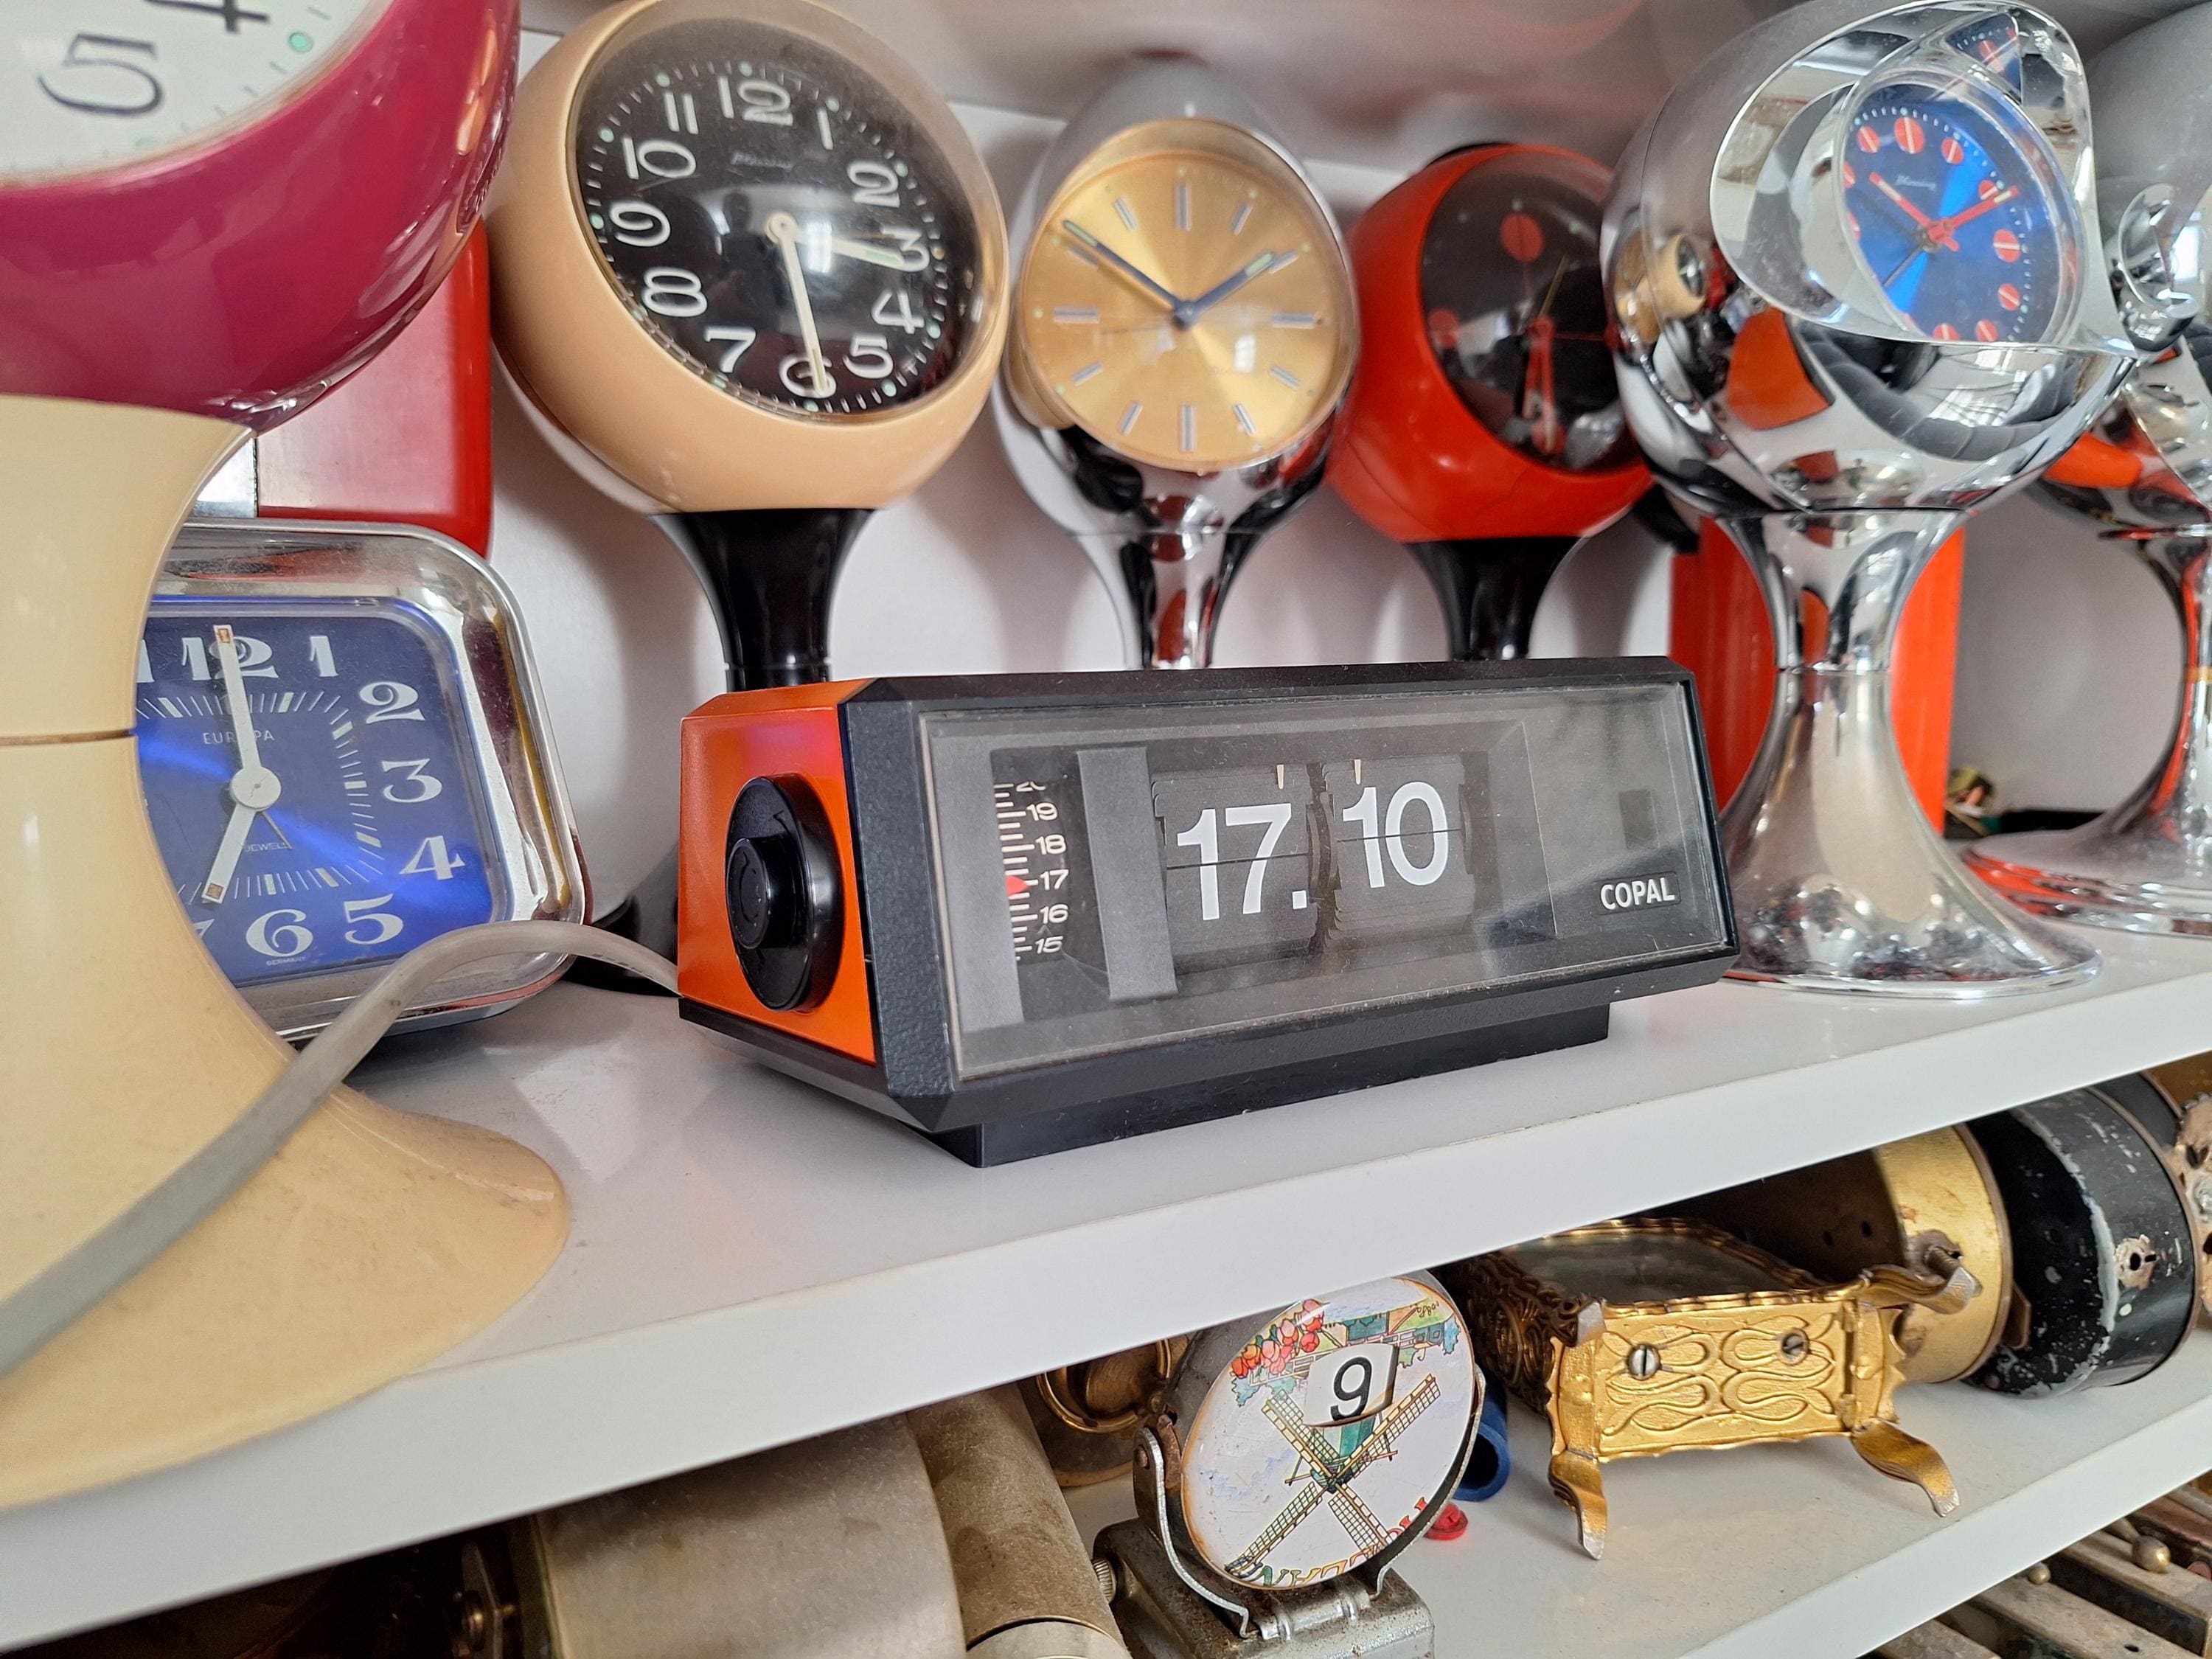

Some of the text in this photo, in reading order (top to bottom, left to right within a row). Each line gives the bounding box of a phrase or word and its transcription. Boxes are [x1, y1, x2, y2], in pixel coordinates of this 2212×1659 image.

[37, 32, 164, 116] 5
[665, 91, 698, 134] 11
[717, 76, 793, 126] 12
[817, 109, 833, 150] 1
[622, 136, 696, 179] 10
[847, 161, 900, 208] 2
[609, 201, 670, 246] 9
[642, 268, 707, 317] 8
[871, 292, 925, 334] 4
[704, 327, 756, 372] 7
[843, 332, 894, 379] 5
[181, 636, 279, 681] 12
[310, 636, 338, 677] 1
[359, 681, 425, 724] 2
[203, 730, 275, 745] EURPA
[382, 758, 442, 803] 3
[1026, 802, 1058, 821] 19
[1035, 834, 1067, 855] 18
[1343, 781, 1448, 888] 10
[398, 835, 466, 880] 4
[1040, 869, 1069, 890] 17
[1040, 904, 1068, 924] 16
[1600, 877, 1675, 910] COPAL
[246, 908, 313, 956] 6
[344, 894, 403, 945] 5
[1035, 935, 1064, 953] 15
